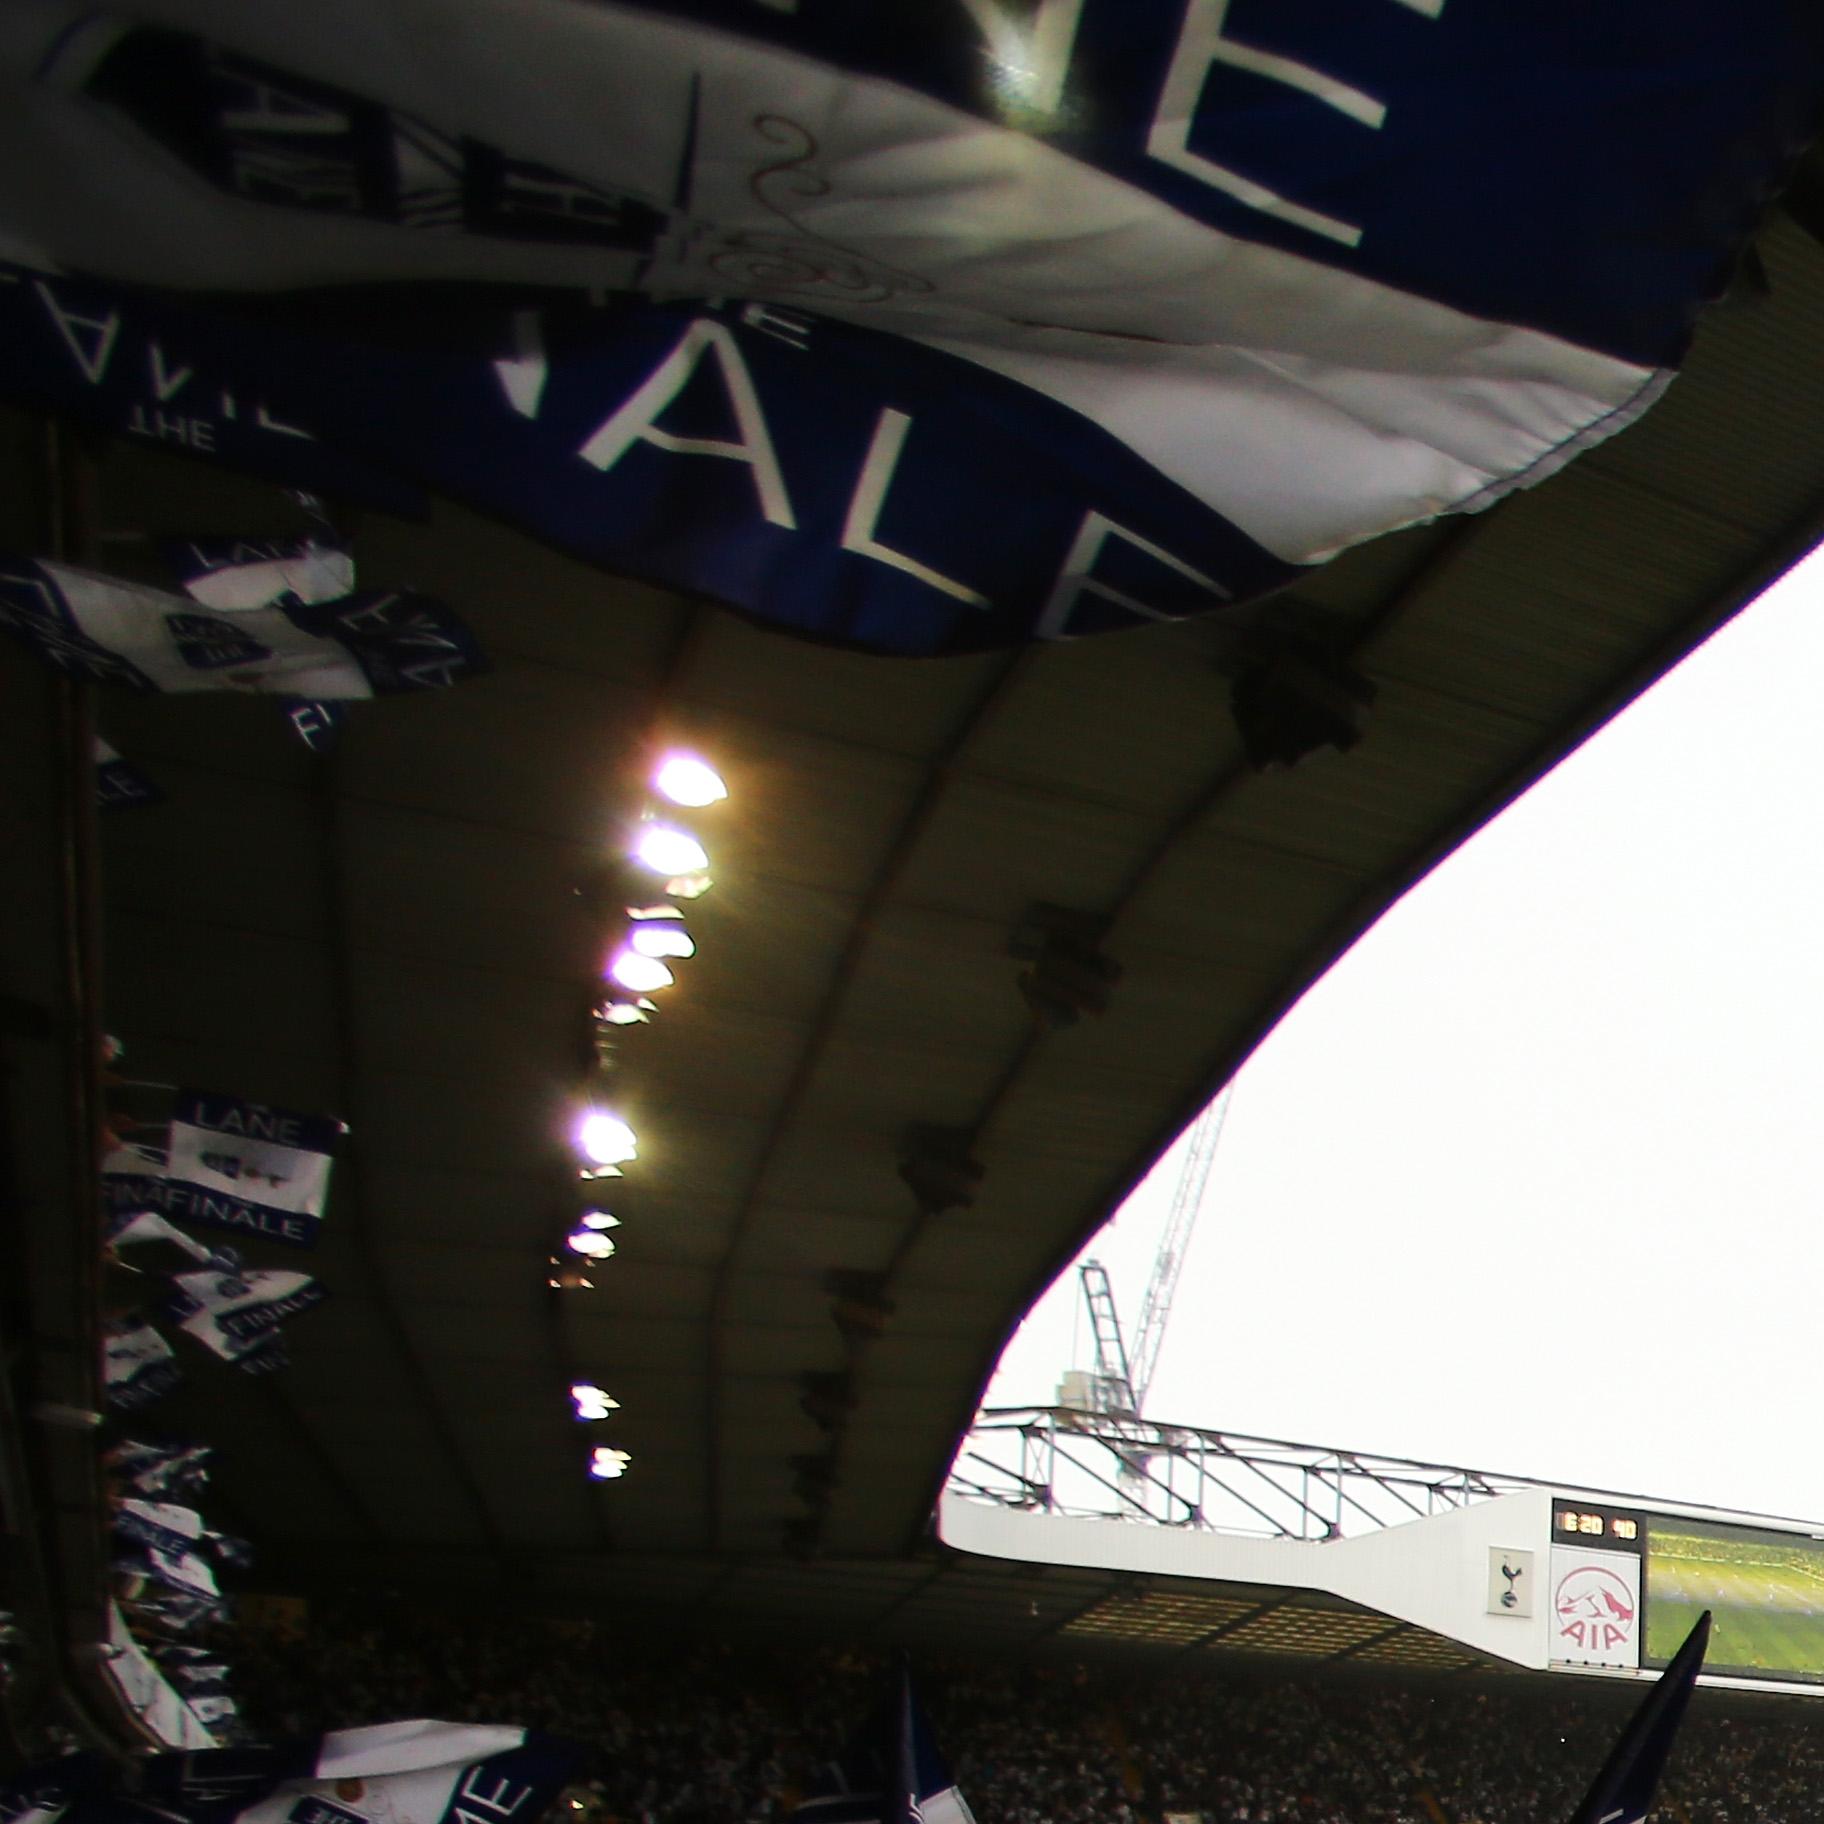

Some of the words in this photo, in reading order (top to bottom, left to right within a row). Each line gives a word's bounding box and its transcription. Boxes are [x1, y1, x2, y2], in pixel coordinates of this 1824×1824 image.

[196, 1101, 301, 1146] LANE
[166, 1189, 307, 1243] FINALE
[1560, 1619, 1629, 1652] AIA
